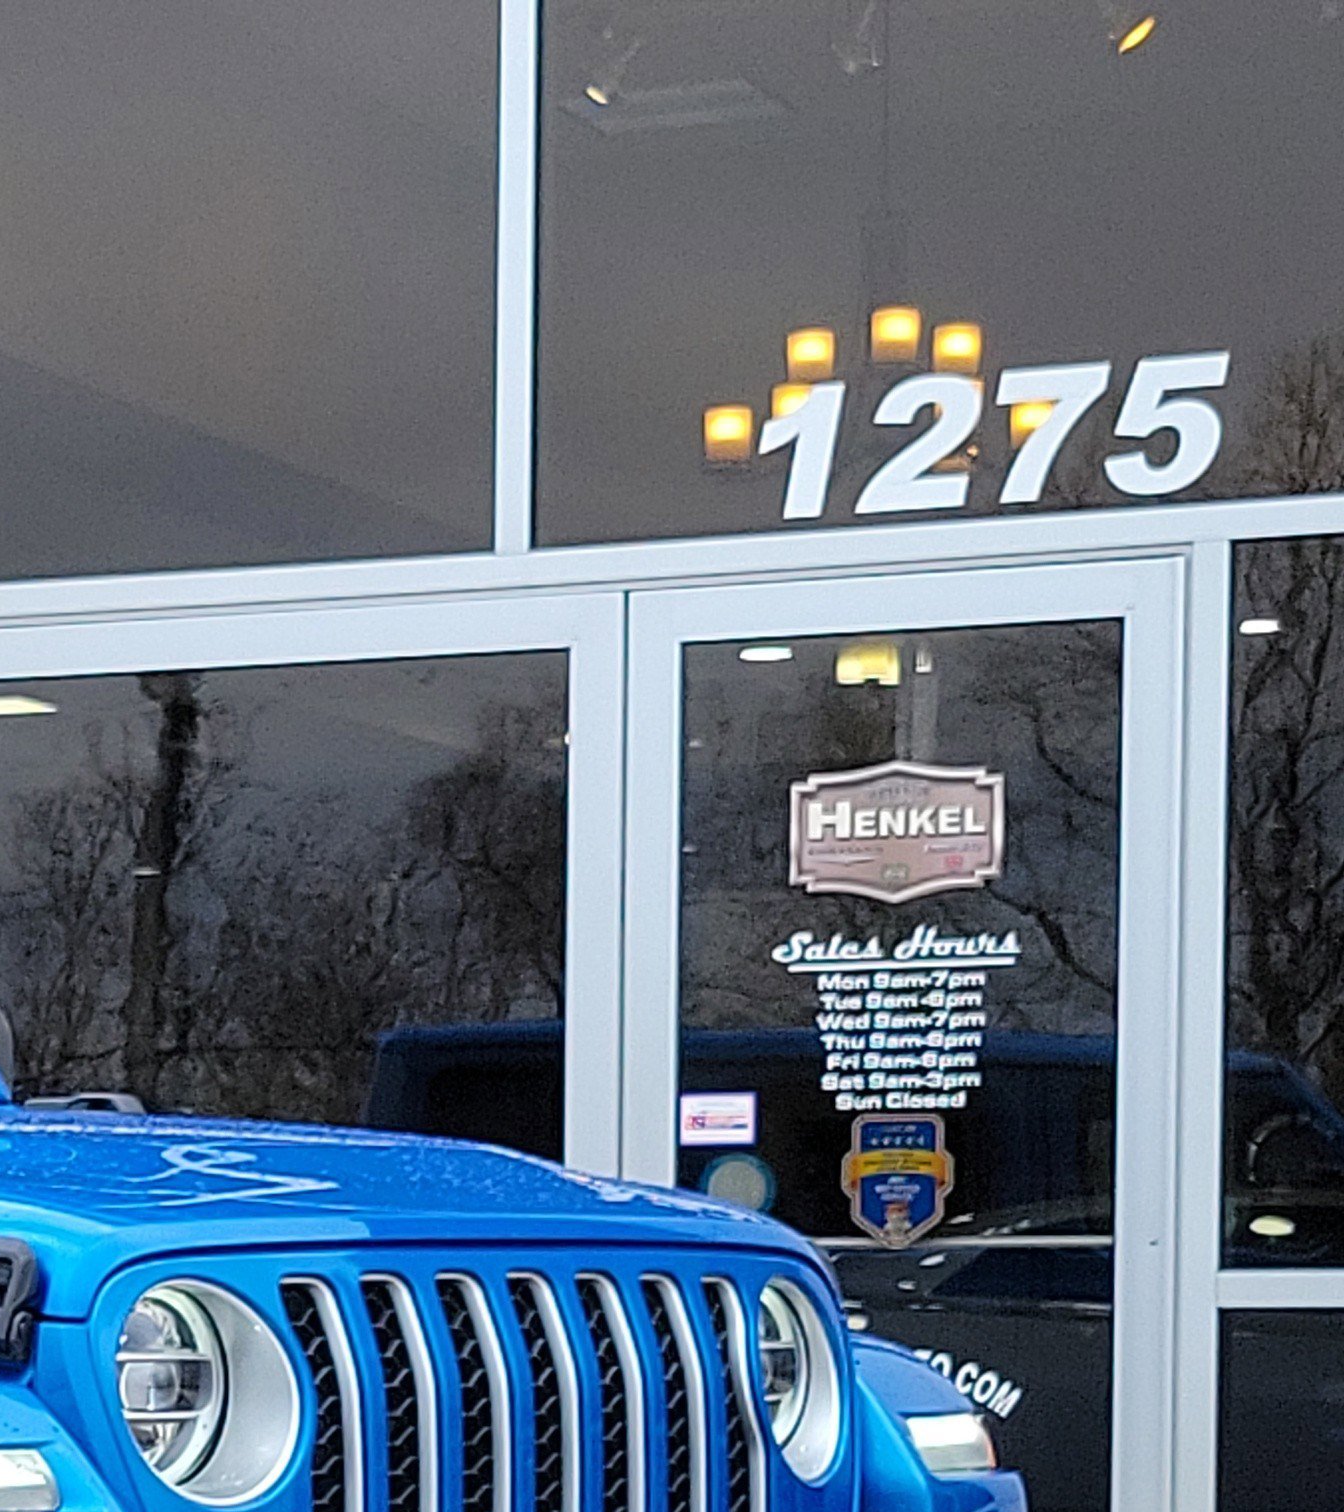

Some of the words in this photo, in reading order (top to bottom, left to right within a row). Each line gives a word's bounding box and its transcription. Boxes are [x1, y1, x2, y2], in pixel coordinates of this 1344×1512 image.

[758, 350, 1230, 520] 1275
[807, 800, 987, 843] HENKEL
[771, 931, 884, 963] Sales
[893, 924, 1021, 960] Hours
[817, 973, 870, 991] Mon
[819, 992, 862, 1011] Tue
[815, 1010, 871, 1031] Wed
[819, 1033, 866, 1050] Thu
[826, 1052, 860, 1070] Fri
[821, 1073, 865, 1091] Sat
[835, 1092, 882, 1111] Sun
[885, 1090, 968, 1109] Closed
